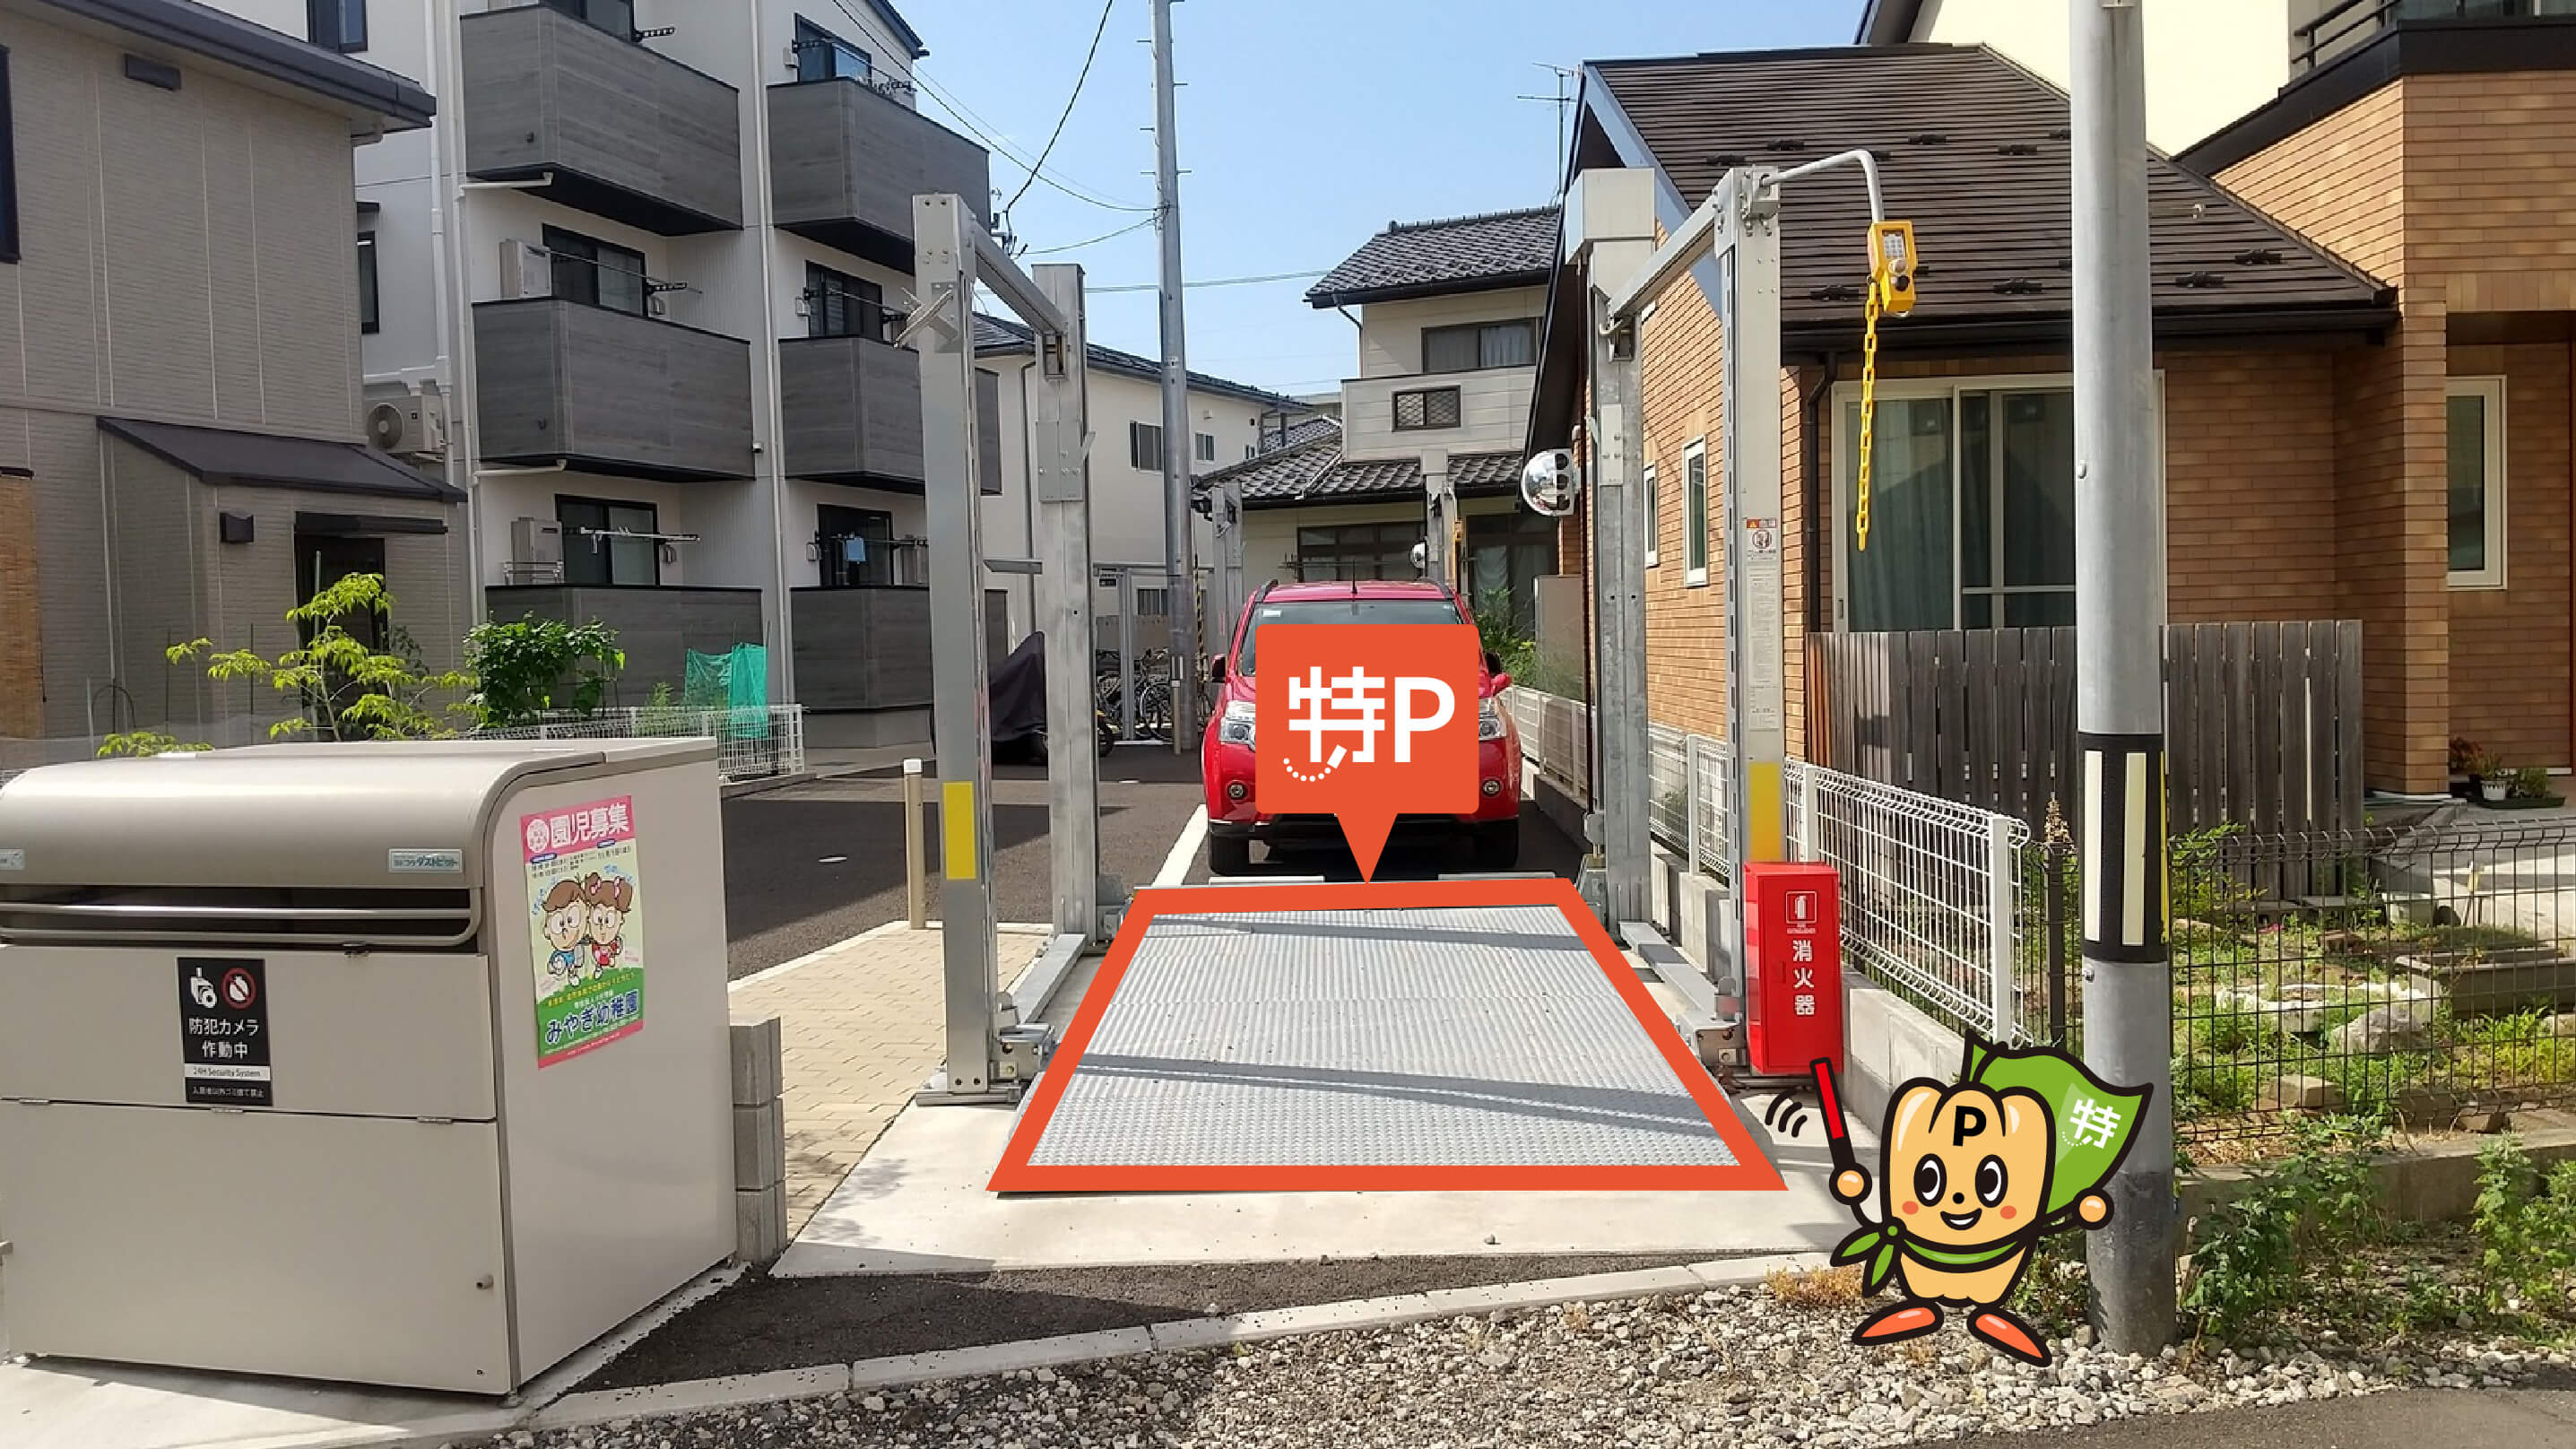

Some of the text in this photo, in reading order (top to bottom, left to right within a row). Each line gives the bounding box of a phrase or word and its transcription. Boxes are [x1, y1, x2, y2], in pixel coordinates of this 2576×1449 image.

[550, 803, 630, 849] 園児募集
[1792, 940, 1816, 1016] 消火器
[188, 1018, 259, 1037] 防犯カメラ
[545, 989, 639, 1045] みやぎ幼稚園
[202, 1040, 248, 1060] 作動中
